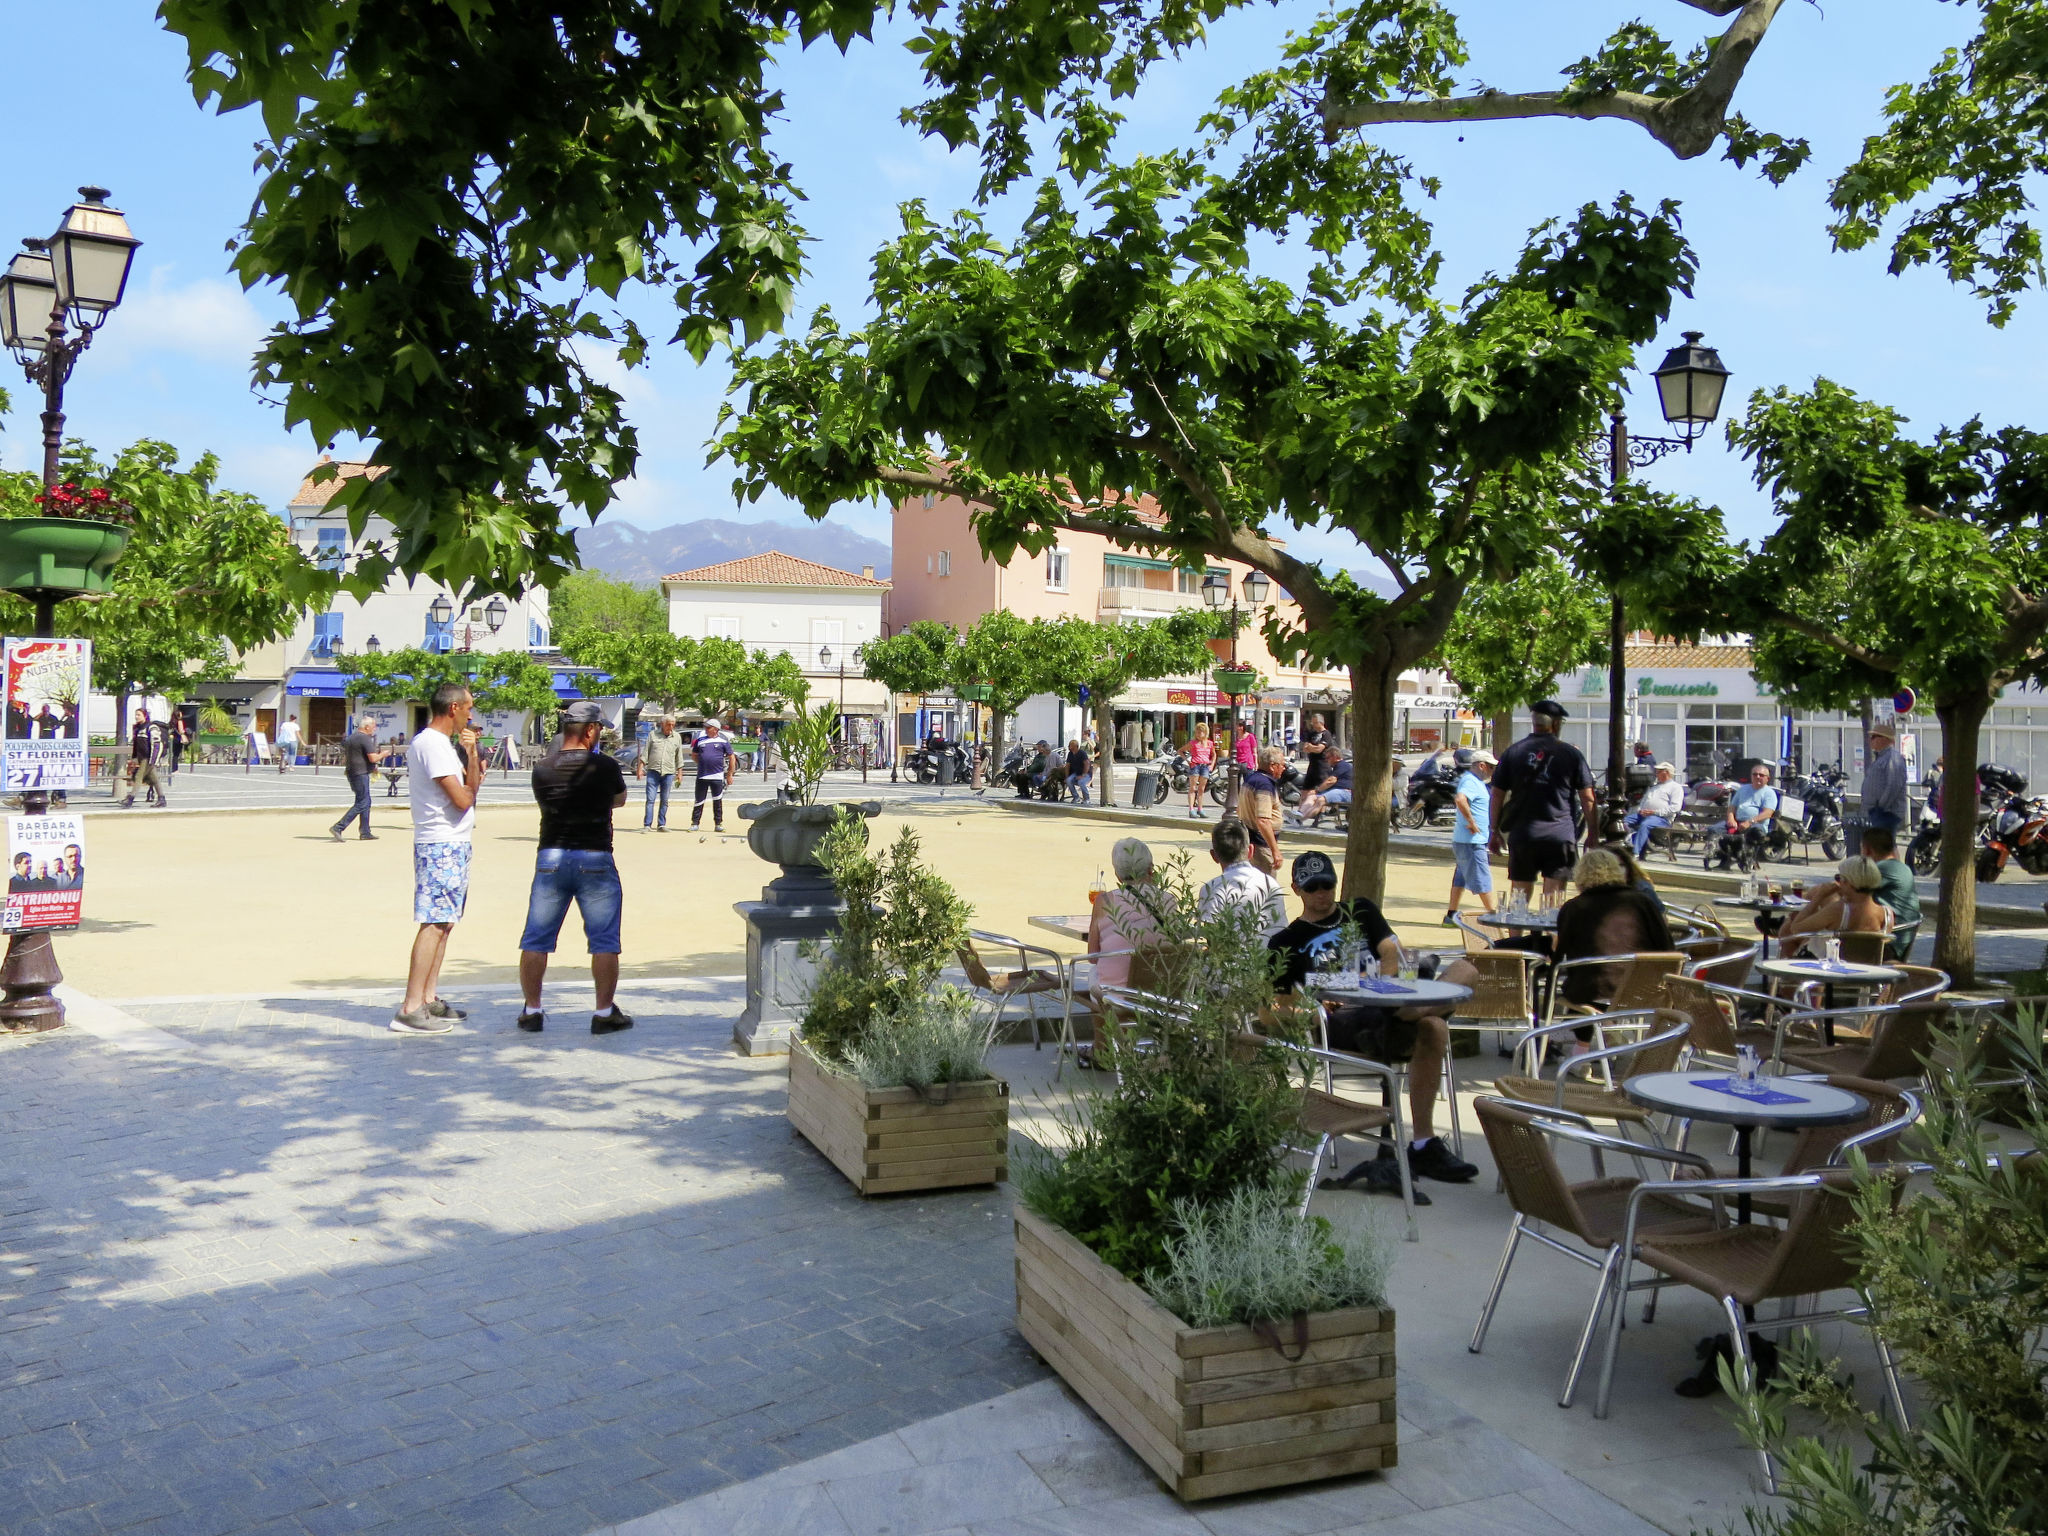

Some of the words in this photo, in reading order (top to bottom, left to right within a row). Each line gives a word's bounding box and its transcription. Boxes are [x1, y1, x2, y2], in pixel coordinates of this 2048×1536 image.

[26, 655, 82, 677] NUSTRALE
[302, 688, 319, 696] BAR
[1307, 693, 1320, 701] Bar
[5, 742, 52, 750] POLYPHONIES
[54, 741, 81, 750] CORSES
[28, 751, 82, 759] FLORENT
[43, 764, 81, 776] MAI
[8, 769, 39, 787] 27
[17, 822, 75, 830] BARBARA
[18, 831, 75, 840] FURTUNA
[6, 891, 80, 906] PATRIMONIU
[6, 911, 21, 922] 29
